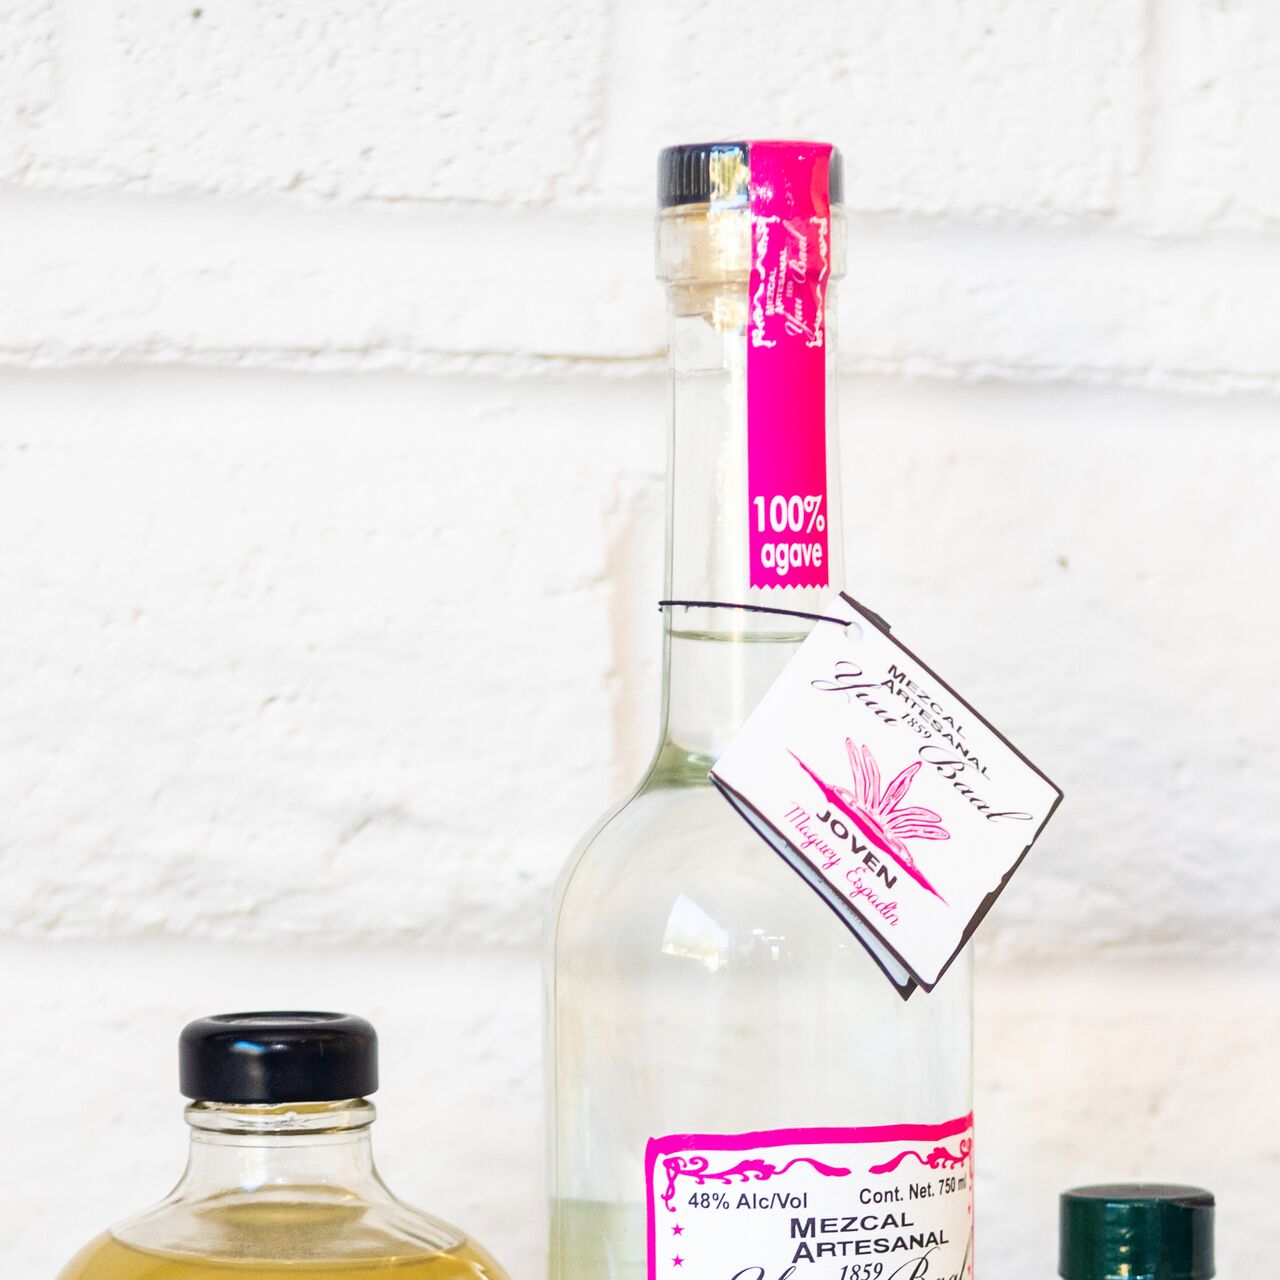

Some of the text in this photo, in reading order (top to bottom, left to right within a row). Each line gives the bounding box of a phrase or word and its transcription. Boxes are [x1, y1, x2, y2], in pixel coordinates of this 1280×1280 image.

[753, 494, 825, 533] 100%
[761, 542, 823, 576] agave
[887, 664, 966, 740] MEZCAL
[810, 661, 1033, 823] Yuu Baal
[880, 679, 992, 780] ARTESANAL
[901, 712, 933, 739] 1859
[784, 801, 842, 870] Maguey
[816, 811, 898, 889] JOVEN
[688, 1192, 730, 1210] 48%
[736, 1192, 808, 1210] Alc/Vol
[859, 1188, 904, 1206] Cont.
[909, 1183, 935, 1200] Net.
[938, 1176, 956, 1195] 750
[790, 1212, 915, 1239] MEZCAL
[791, 1229, 950, 1264] ARTESANAL
